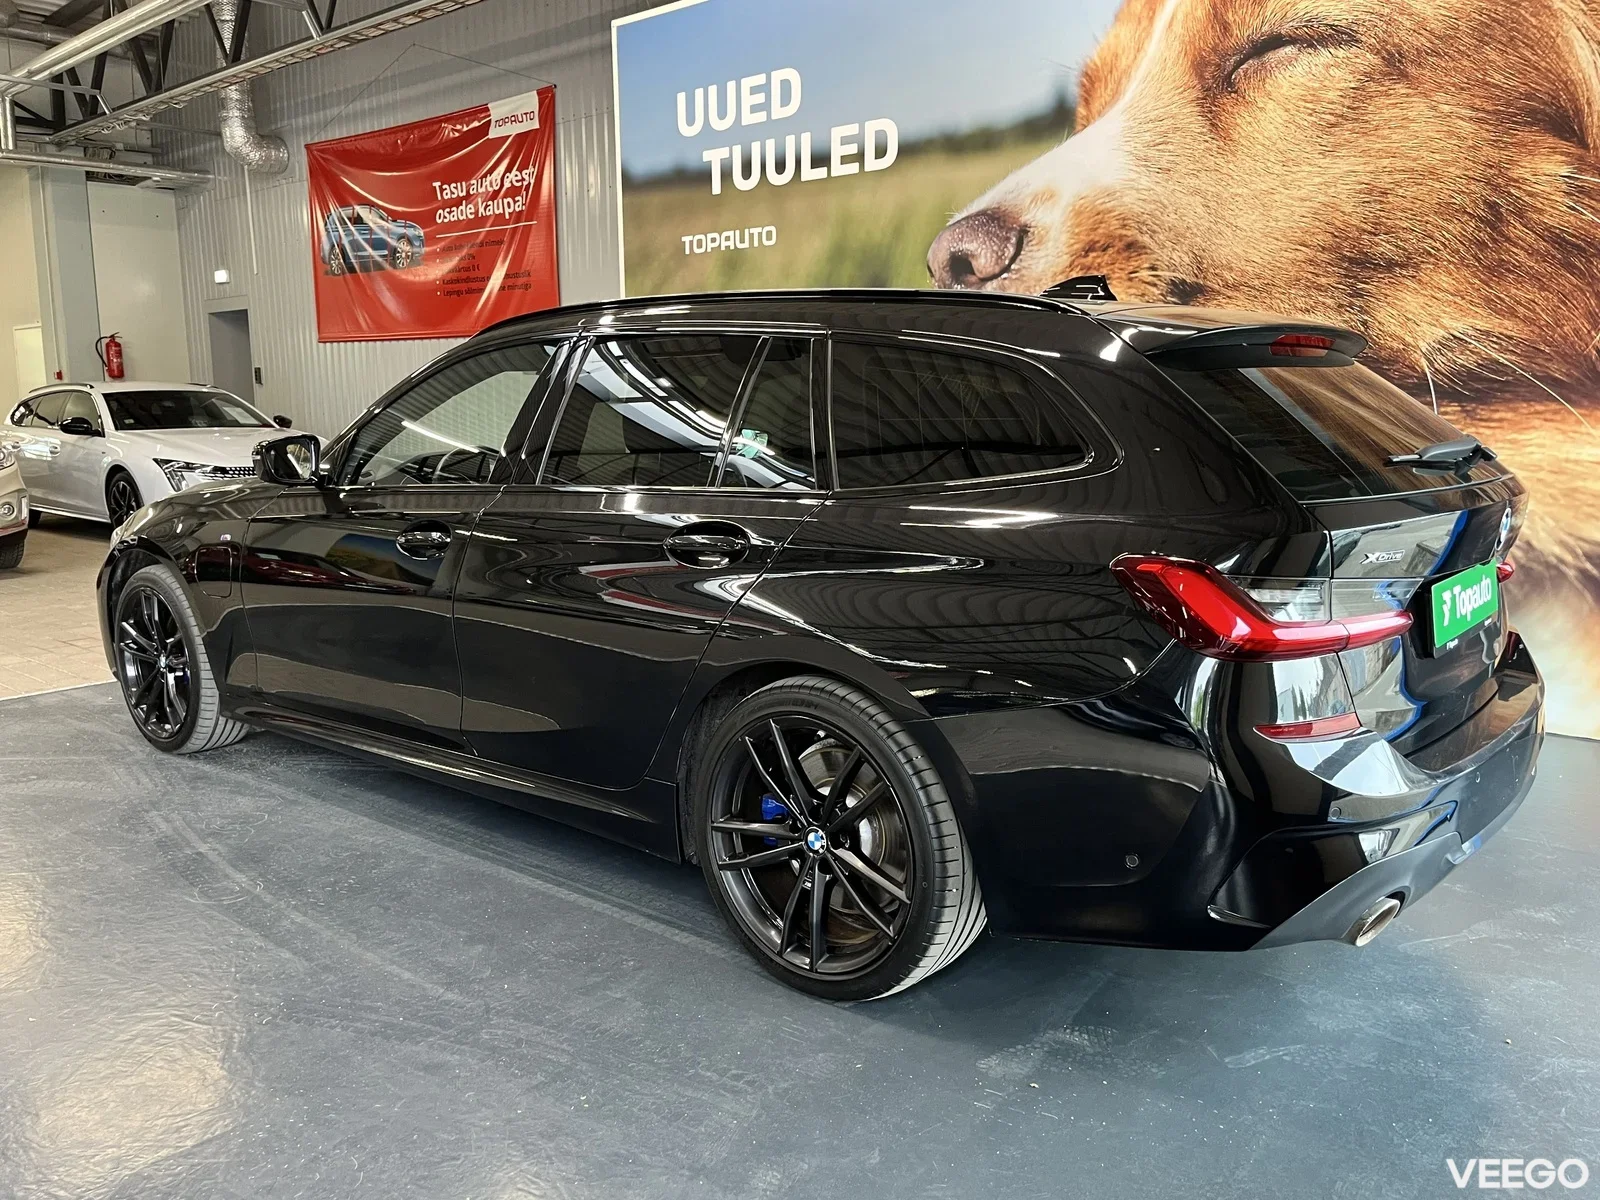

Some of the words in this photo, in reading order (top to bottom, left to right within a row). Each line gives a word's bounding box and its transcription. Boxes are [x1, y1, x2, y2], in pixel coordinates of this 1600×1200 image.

[494, 110, 535, 128] TOPAUTO
[676, 67, 802, 137] UUED
[702, 117, 899, 195] TUULED
[432, 181, 467, 200] Tasu
[469, 173, 501, 195] auto
[503, 166, 535, 188] eest
[435, 200, 475, 223] osade
[478, 191, 526, 219] kaupa!
[681, 225, 777, 255] TOPAUTO
[1452, 575, 1492, 622] Topauto
